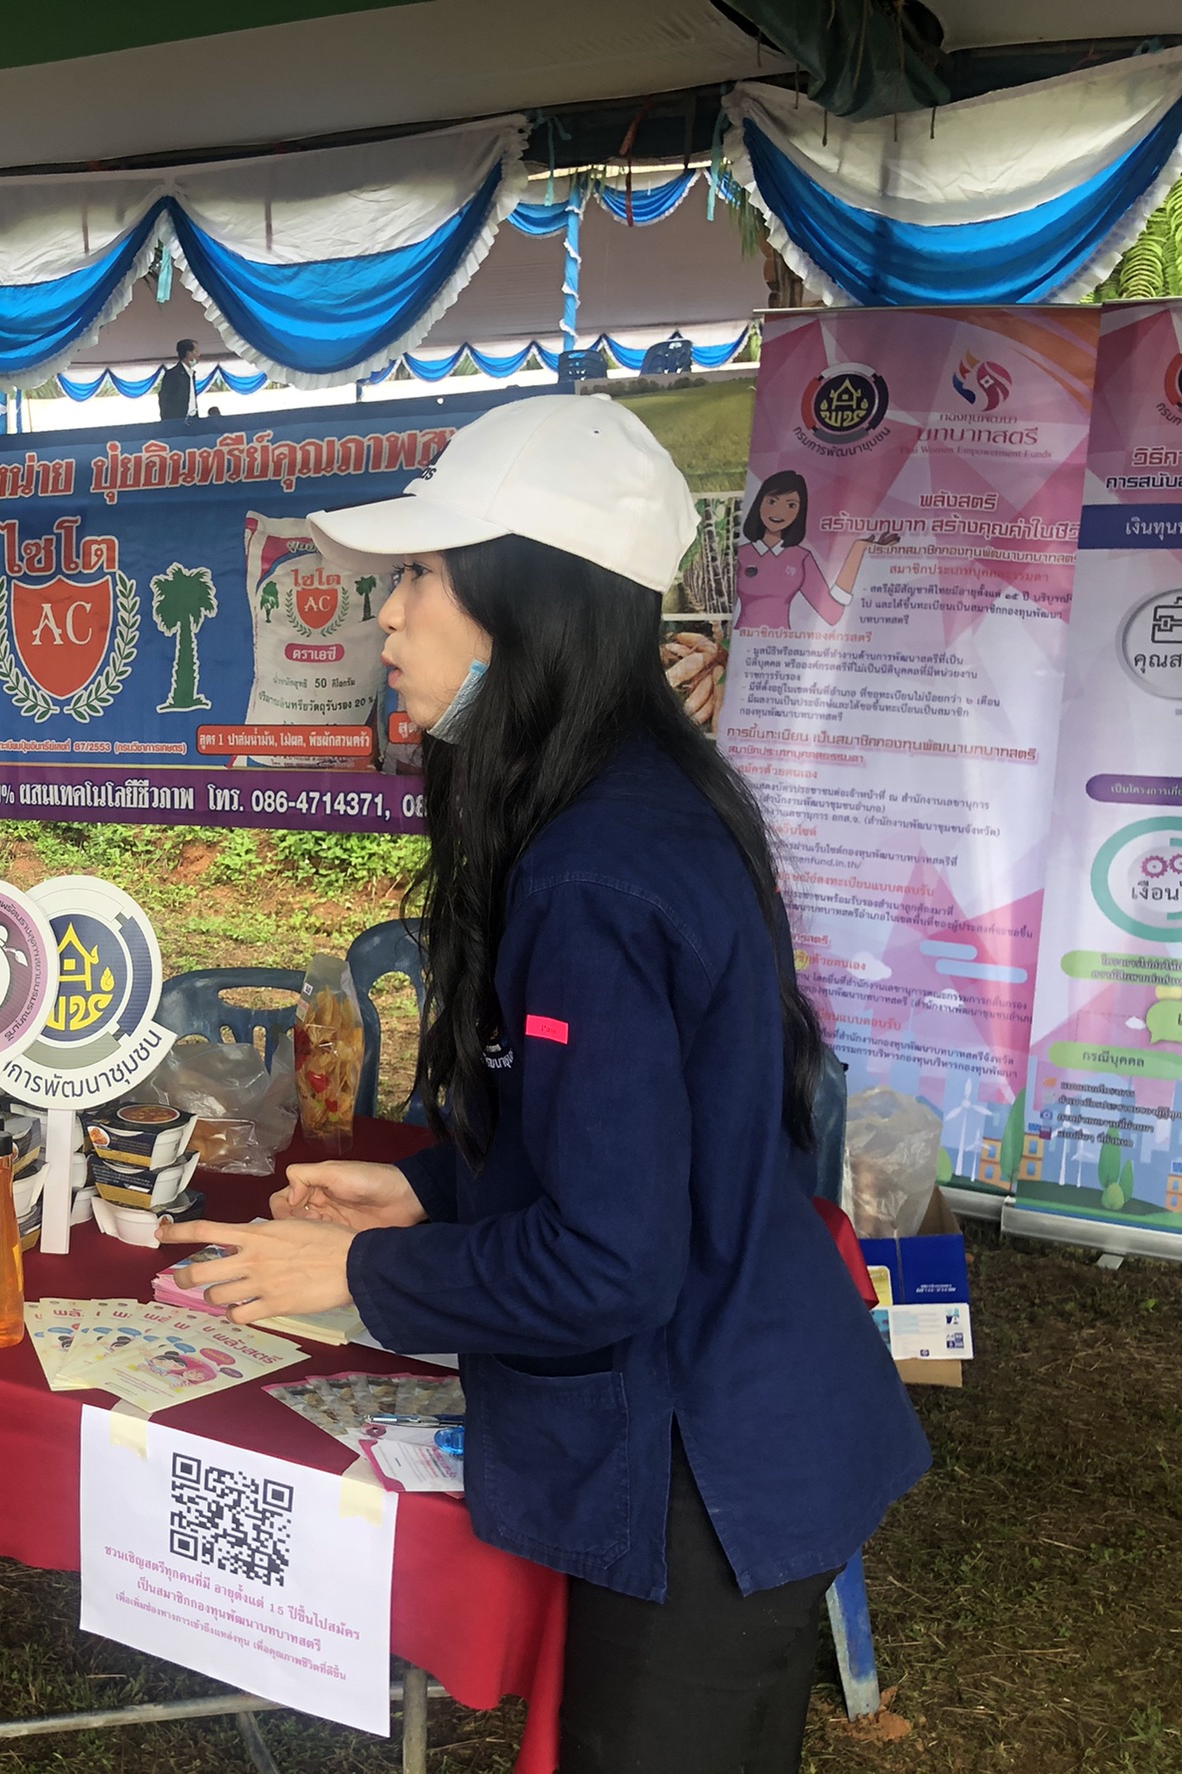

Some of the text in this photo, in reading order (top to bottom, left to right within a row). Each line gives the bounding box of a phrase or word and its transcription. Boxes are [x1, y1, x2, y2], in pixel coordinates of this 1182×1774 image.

[793, 426, 891, 458] กรมการพัฒนาชุมชน
[917, 427, 1039, 445] บทบาทสตรี
[921, 446, 954, 455] Women
[957, 446, 1021, 459] Empowerment
[90, 426, 456, 504] ปุ๋ยอินทรีย์คุณภาพส
[920, 490, 997, 511] พลังสตรี
[820, 511, 926, 533] สร้างบทบาท
[291, 567, 341, 587] ไซโต
[304, 596, 331, 613] AC
[31, 600, 94, 647] AC
[314, 678, 327, 688] 50
[355, 697, 367, 708] 20
[199, 732, 216, 750] สูตร
[218, 734, 223, 746] 1
[309, 732, 370, 750] พืชผักสวนครัว
[727, 723, 809, 743] การขึ้นทะเบียน
[74, 741, 111, 752] 87/2553
[207, 784, 245, 812] โทร.
[251, 790, 391, 821] 086-4714371,
[3, 1029, 163, 1099] การพัฒนาชุมชน
[1082, 1050, 1145, 1068] กรณีบุคคล
[213, 1332, 284, 1365] พลังสตรี
[105, 1545, 361, 1641] ชวนเชิญสตรีทุกคนที่มี อายุตั้งแต่ 15 ปีขึ้นไปสมัคร
[137, 1576, 322, 1652] เป็นสมาชิกกองทุนพัฒนาบทบาทสตรี
[115, 1591, 347, 1681] เพื่อเพิ่มช่องทางการเข้าถึงแหล่งทุน เพื่อคุณภาพชีวิตที่ดีขึ้น
